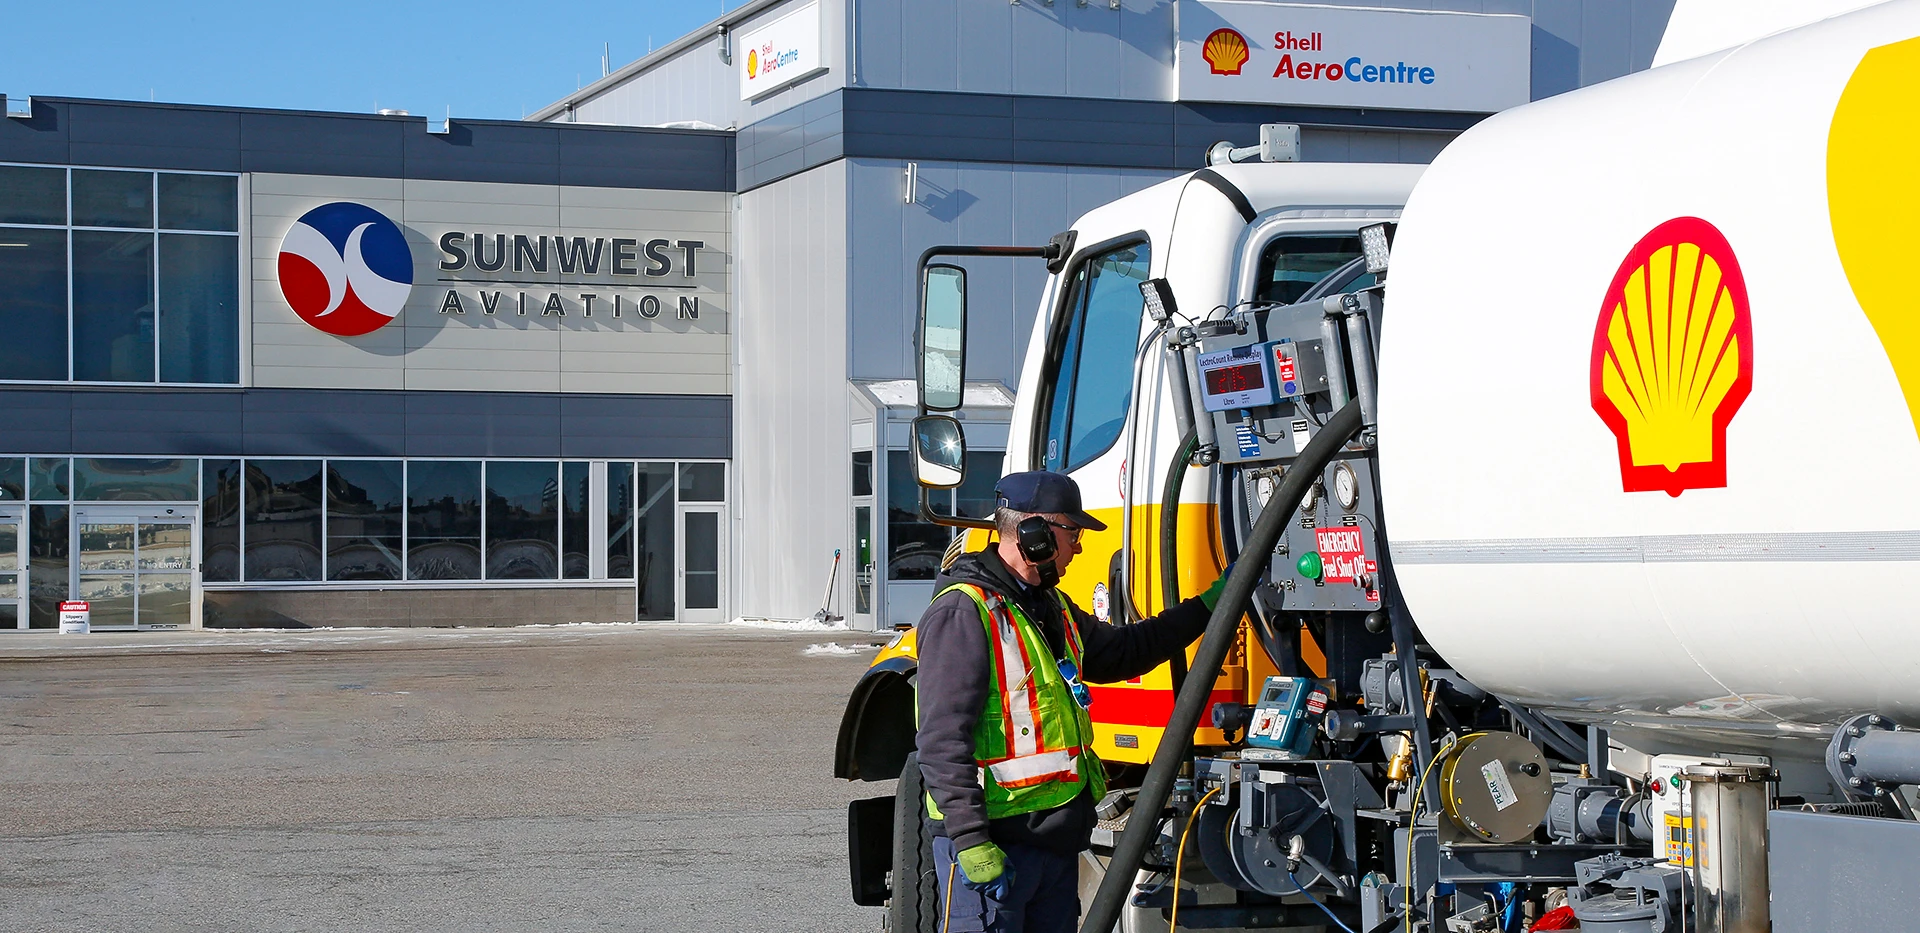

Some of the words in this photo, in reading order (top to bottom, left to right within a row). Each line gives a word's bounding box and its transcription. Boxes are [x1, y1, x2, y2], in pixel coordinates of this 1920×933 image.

[762, 40, 773, 56] Shell
[1274, 31, 1322, 51] Shell
[762, 49, 798, 75] AeroCentre
[1272, 53, 1435, 85] AeroCentre
[438, 231, 705, 278] SUNWEST
[438, 289, 700, 320] AVIATION
[1318, 531, 1361, 553] EMERGENCY
[1321, 555, 1337, 578] Fuel
[1336, 555, 1354, 578] Shut
[1353, 555, 1367, 576] Off
[1489, 780, 1504, 805] PEAR
